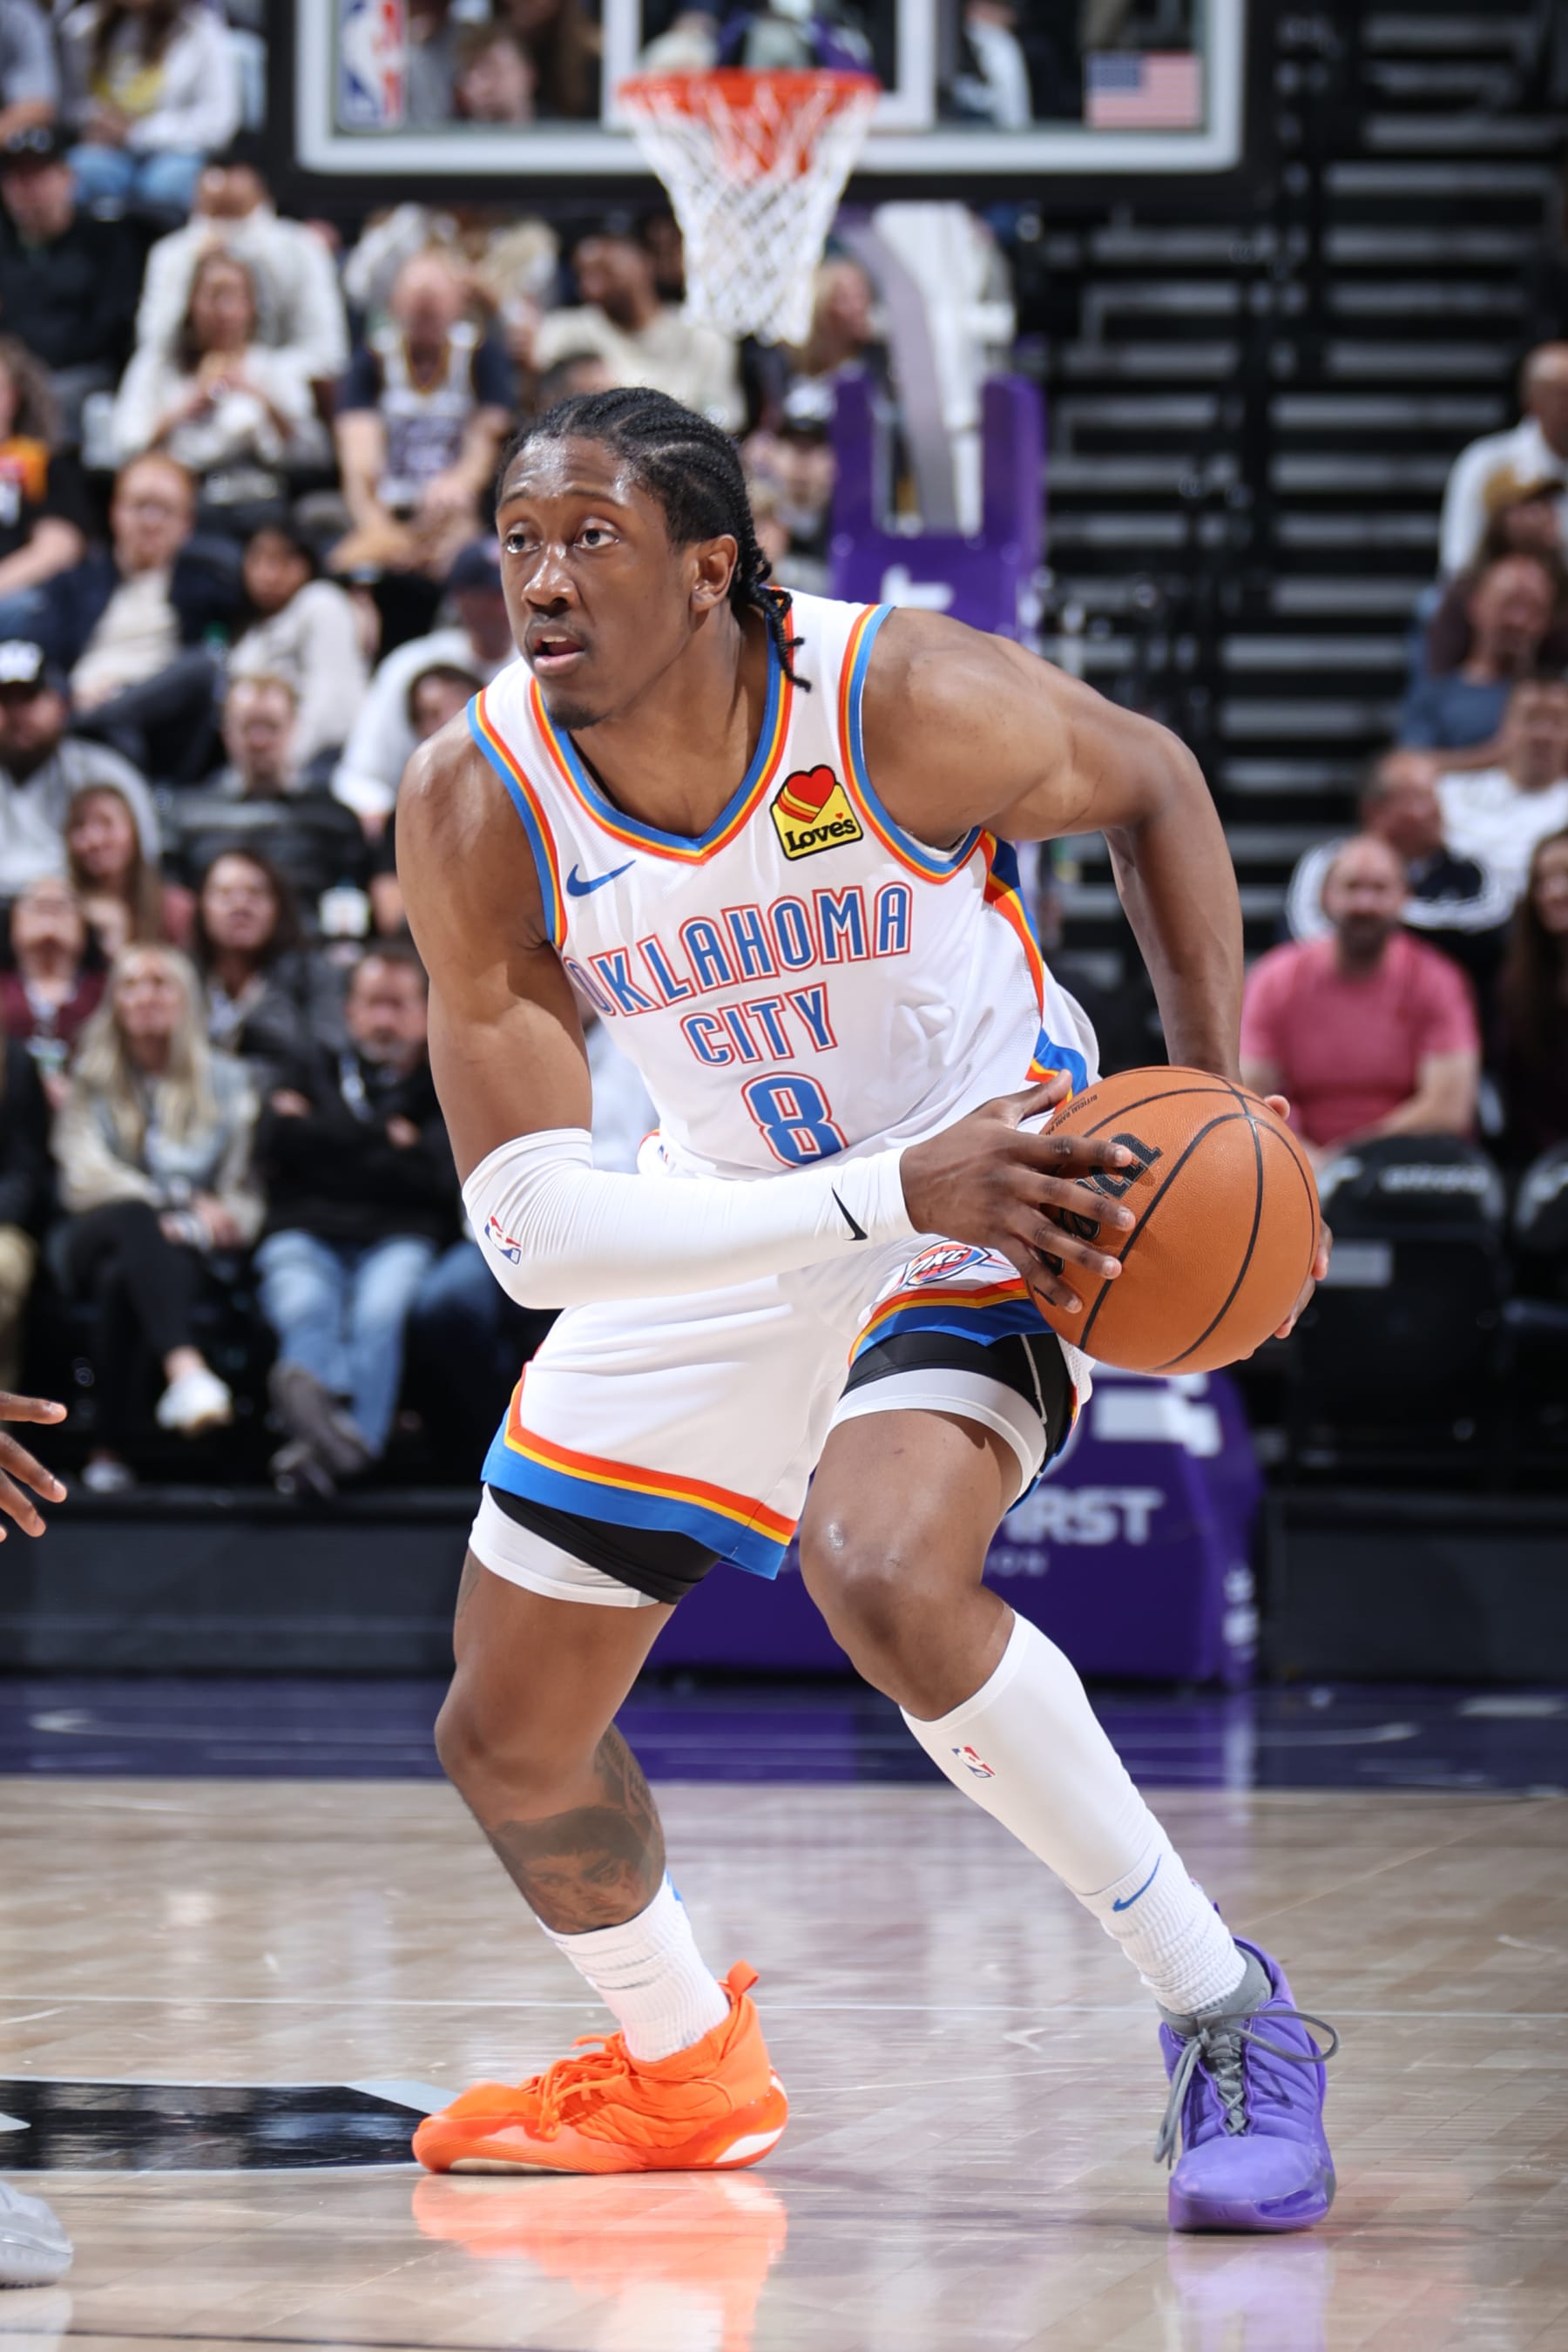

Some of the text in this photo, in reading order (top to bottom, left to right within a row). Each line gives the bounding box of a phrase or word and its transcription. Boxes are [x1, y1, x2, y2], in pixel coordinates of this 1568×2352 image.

[563, 882, 913, 1017] OKLAHOMA
[679, 982, 838, 1066] CITY
[741, 1071, 849, 1169] 8
[1005, 1486, 1165, 1545] IRST
